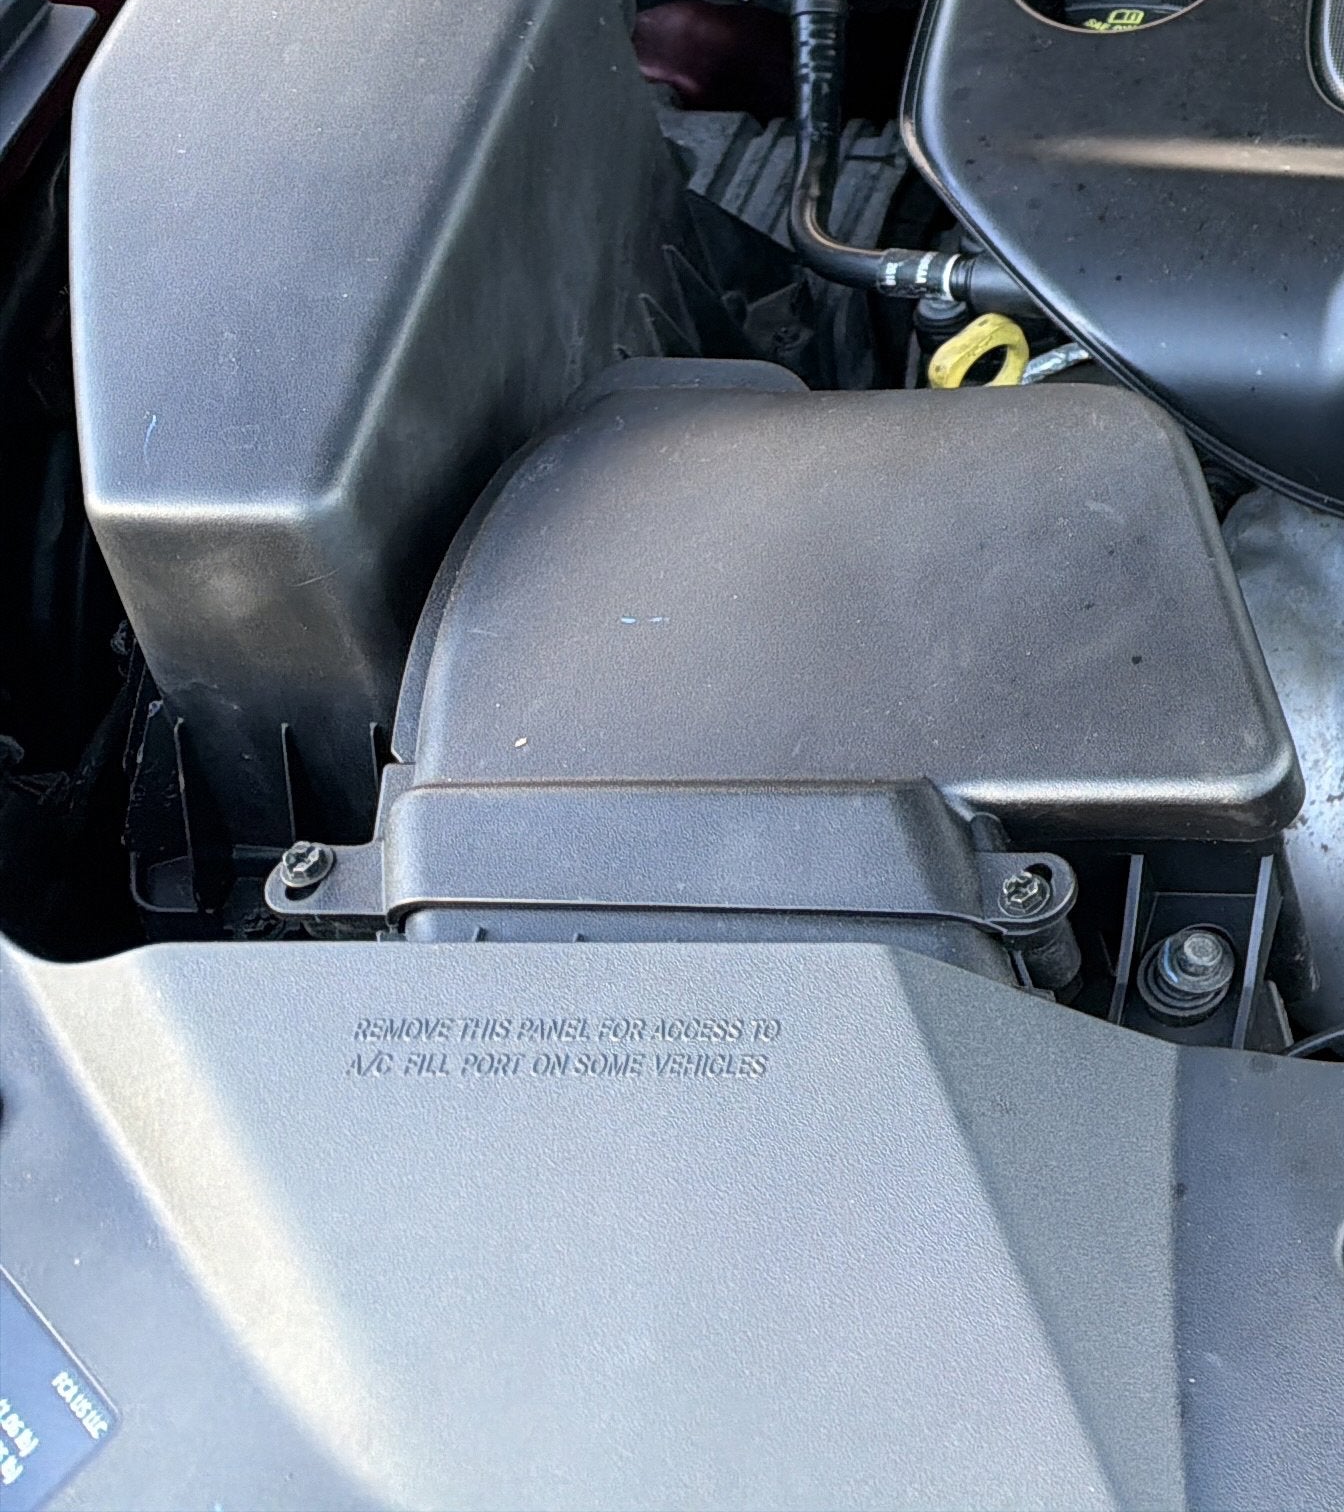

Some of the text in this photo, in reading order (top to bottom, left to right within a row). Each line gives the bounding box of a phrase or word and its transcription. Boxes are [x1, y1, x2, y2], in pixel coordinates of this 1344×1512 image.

[353, 1017, 783, 1042] REMOVE THIS PANEL FOR ACCESS TO
[345, 1052, 769, 1079] A/C FILL PORT ON SOME VEHICLES
